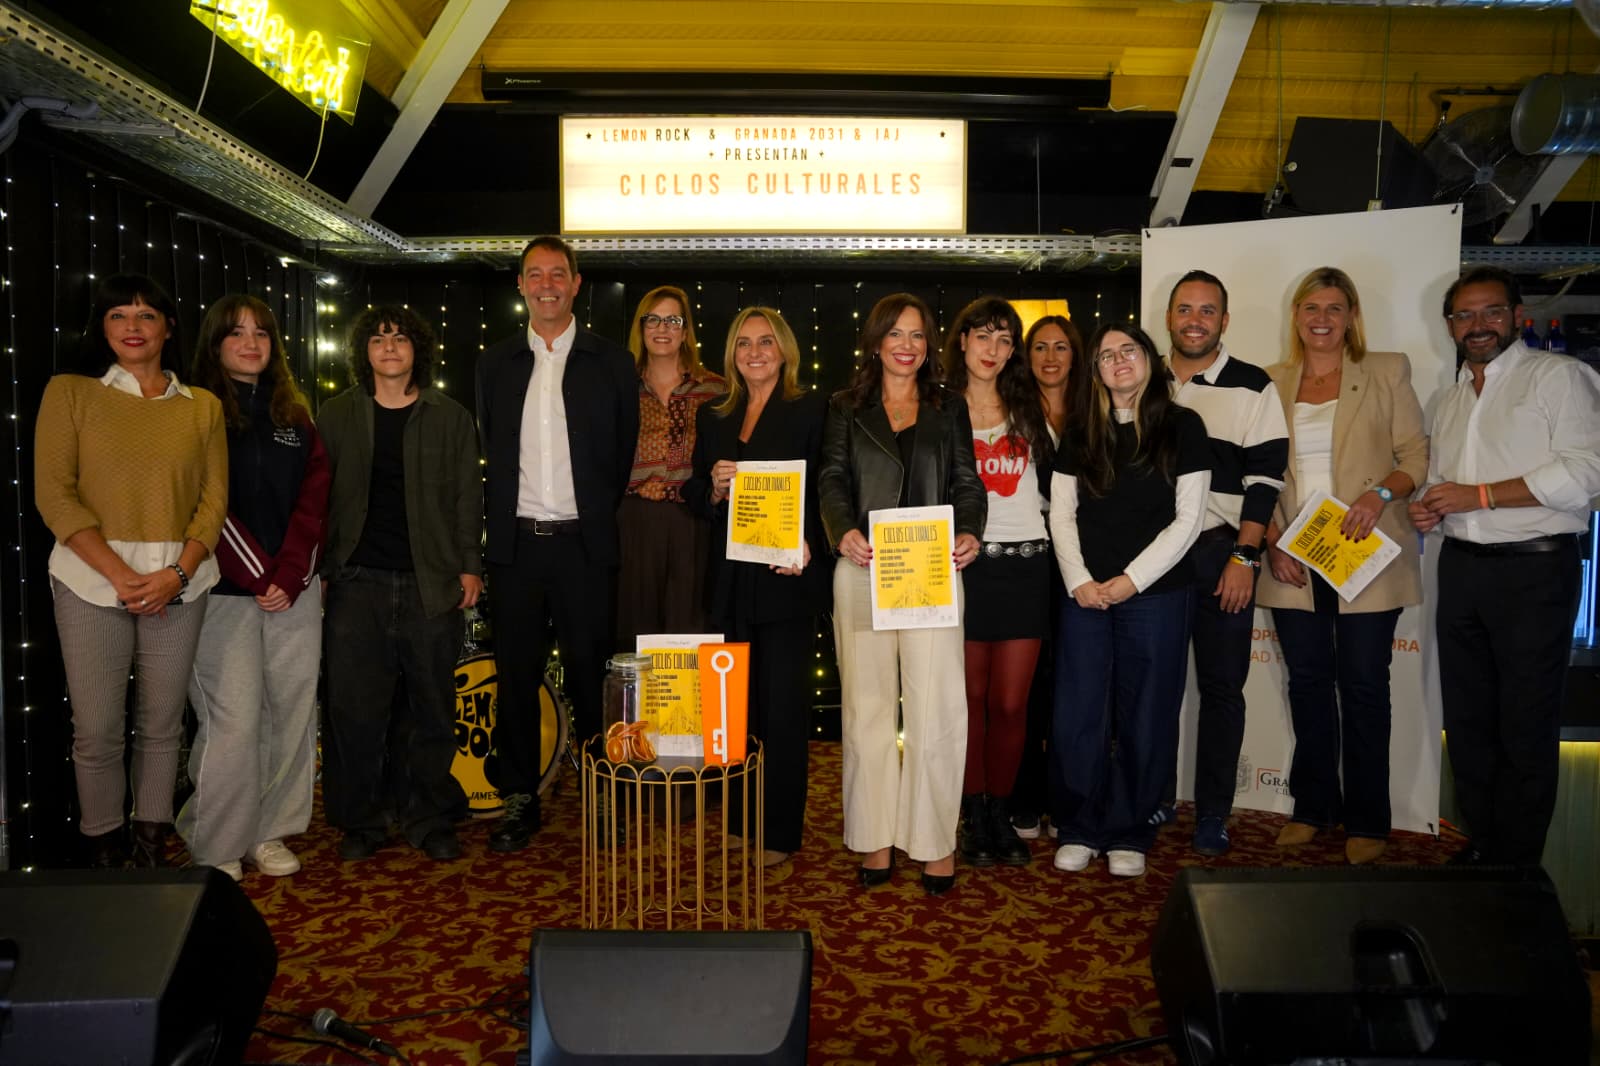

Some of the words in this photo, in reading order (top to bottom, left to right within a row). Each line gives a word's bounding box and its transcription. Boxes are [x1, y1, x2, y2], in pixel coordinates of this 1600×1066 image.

[602, 128, 648, 142] LEMON
[655, 127, 691, 141] ROCK
[708, 127, 716, 140] &
[735, 127, 797, 141] GRANADA
[809, 127, 843, 141] 2031
[854, 127, 862, 141] &
[875, 127, 900, 141] IAJ
[724, 147, 808, 161] PRESENTAN
[619, 172, 721, 196] CICLOS
[746, 171, 922, 195] CULTURALES
[471, 791, 499, 801] JAMES
